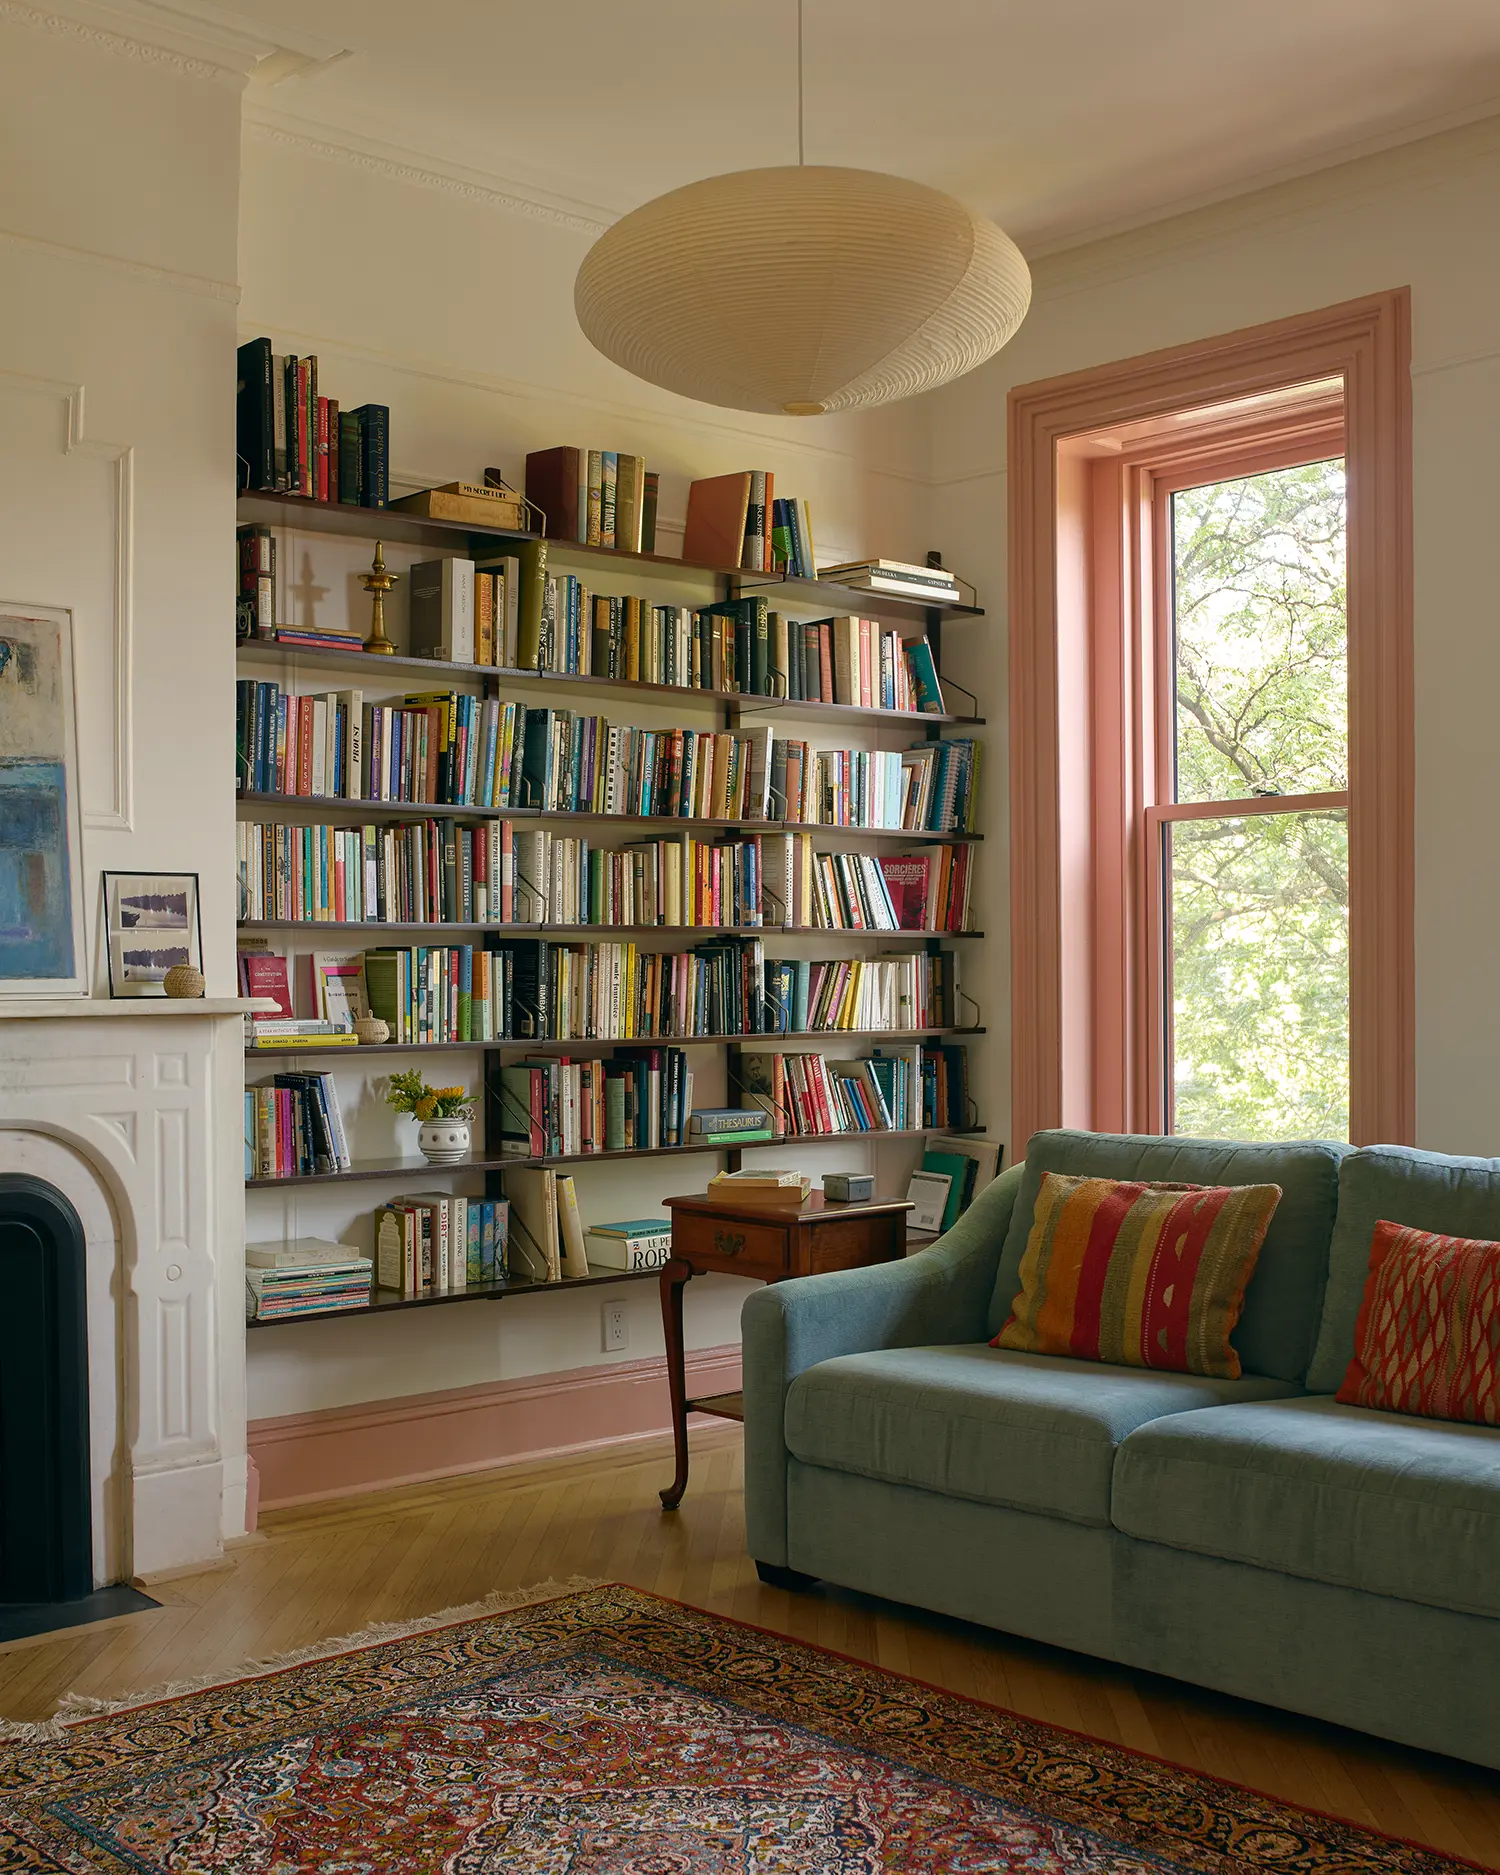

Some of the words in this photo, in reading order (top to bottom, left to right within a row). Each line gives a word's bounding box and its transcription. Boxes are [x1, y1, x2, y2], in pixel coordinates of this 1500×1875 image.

[277, 377, 285, 408] Francesca
[379, 461, 385, 472] AM
[377, 474, 385, 497] RADAR
[604, 505, 616, 534] FRANZEN
[755, 476, 765, 561] DANMARKSHISTORIE
[549, 609, 555, 621] US
[610, 612, 616, 620] ON
[539, 618, 550, 654] Caste
[449, 703, 457, 742] WATCHMEN
[302, 704, 310, 789] DRIFTLESS
[249, 744, 257, 773] READER
[725, 755, 733, 810] HEARTBURN
[812, 1056, 821, 1079] Wolf
[816, 1080, 825, 1098] Hall
[717, 1117, 762, 1130] THESAURUS
[456, 1200, 464, 1213] THE
[440, 1212, 448, 1238] DIRT
[456, 1213, 464, 1225] ART
[456, 1225, 464, 1234] OF
[456, 1234, 464, 1256] EATING
